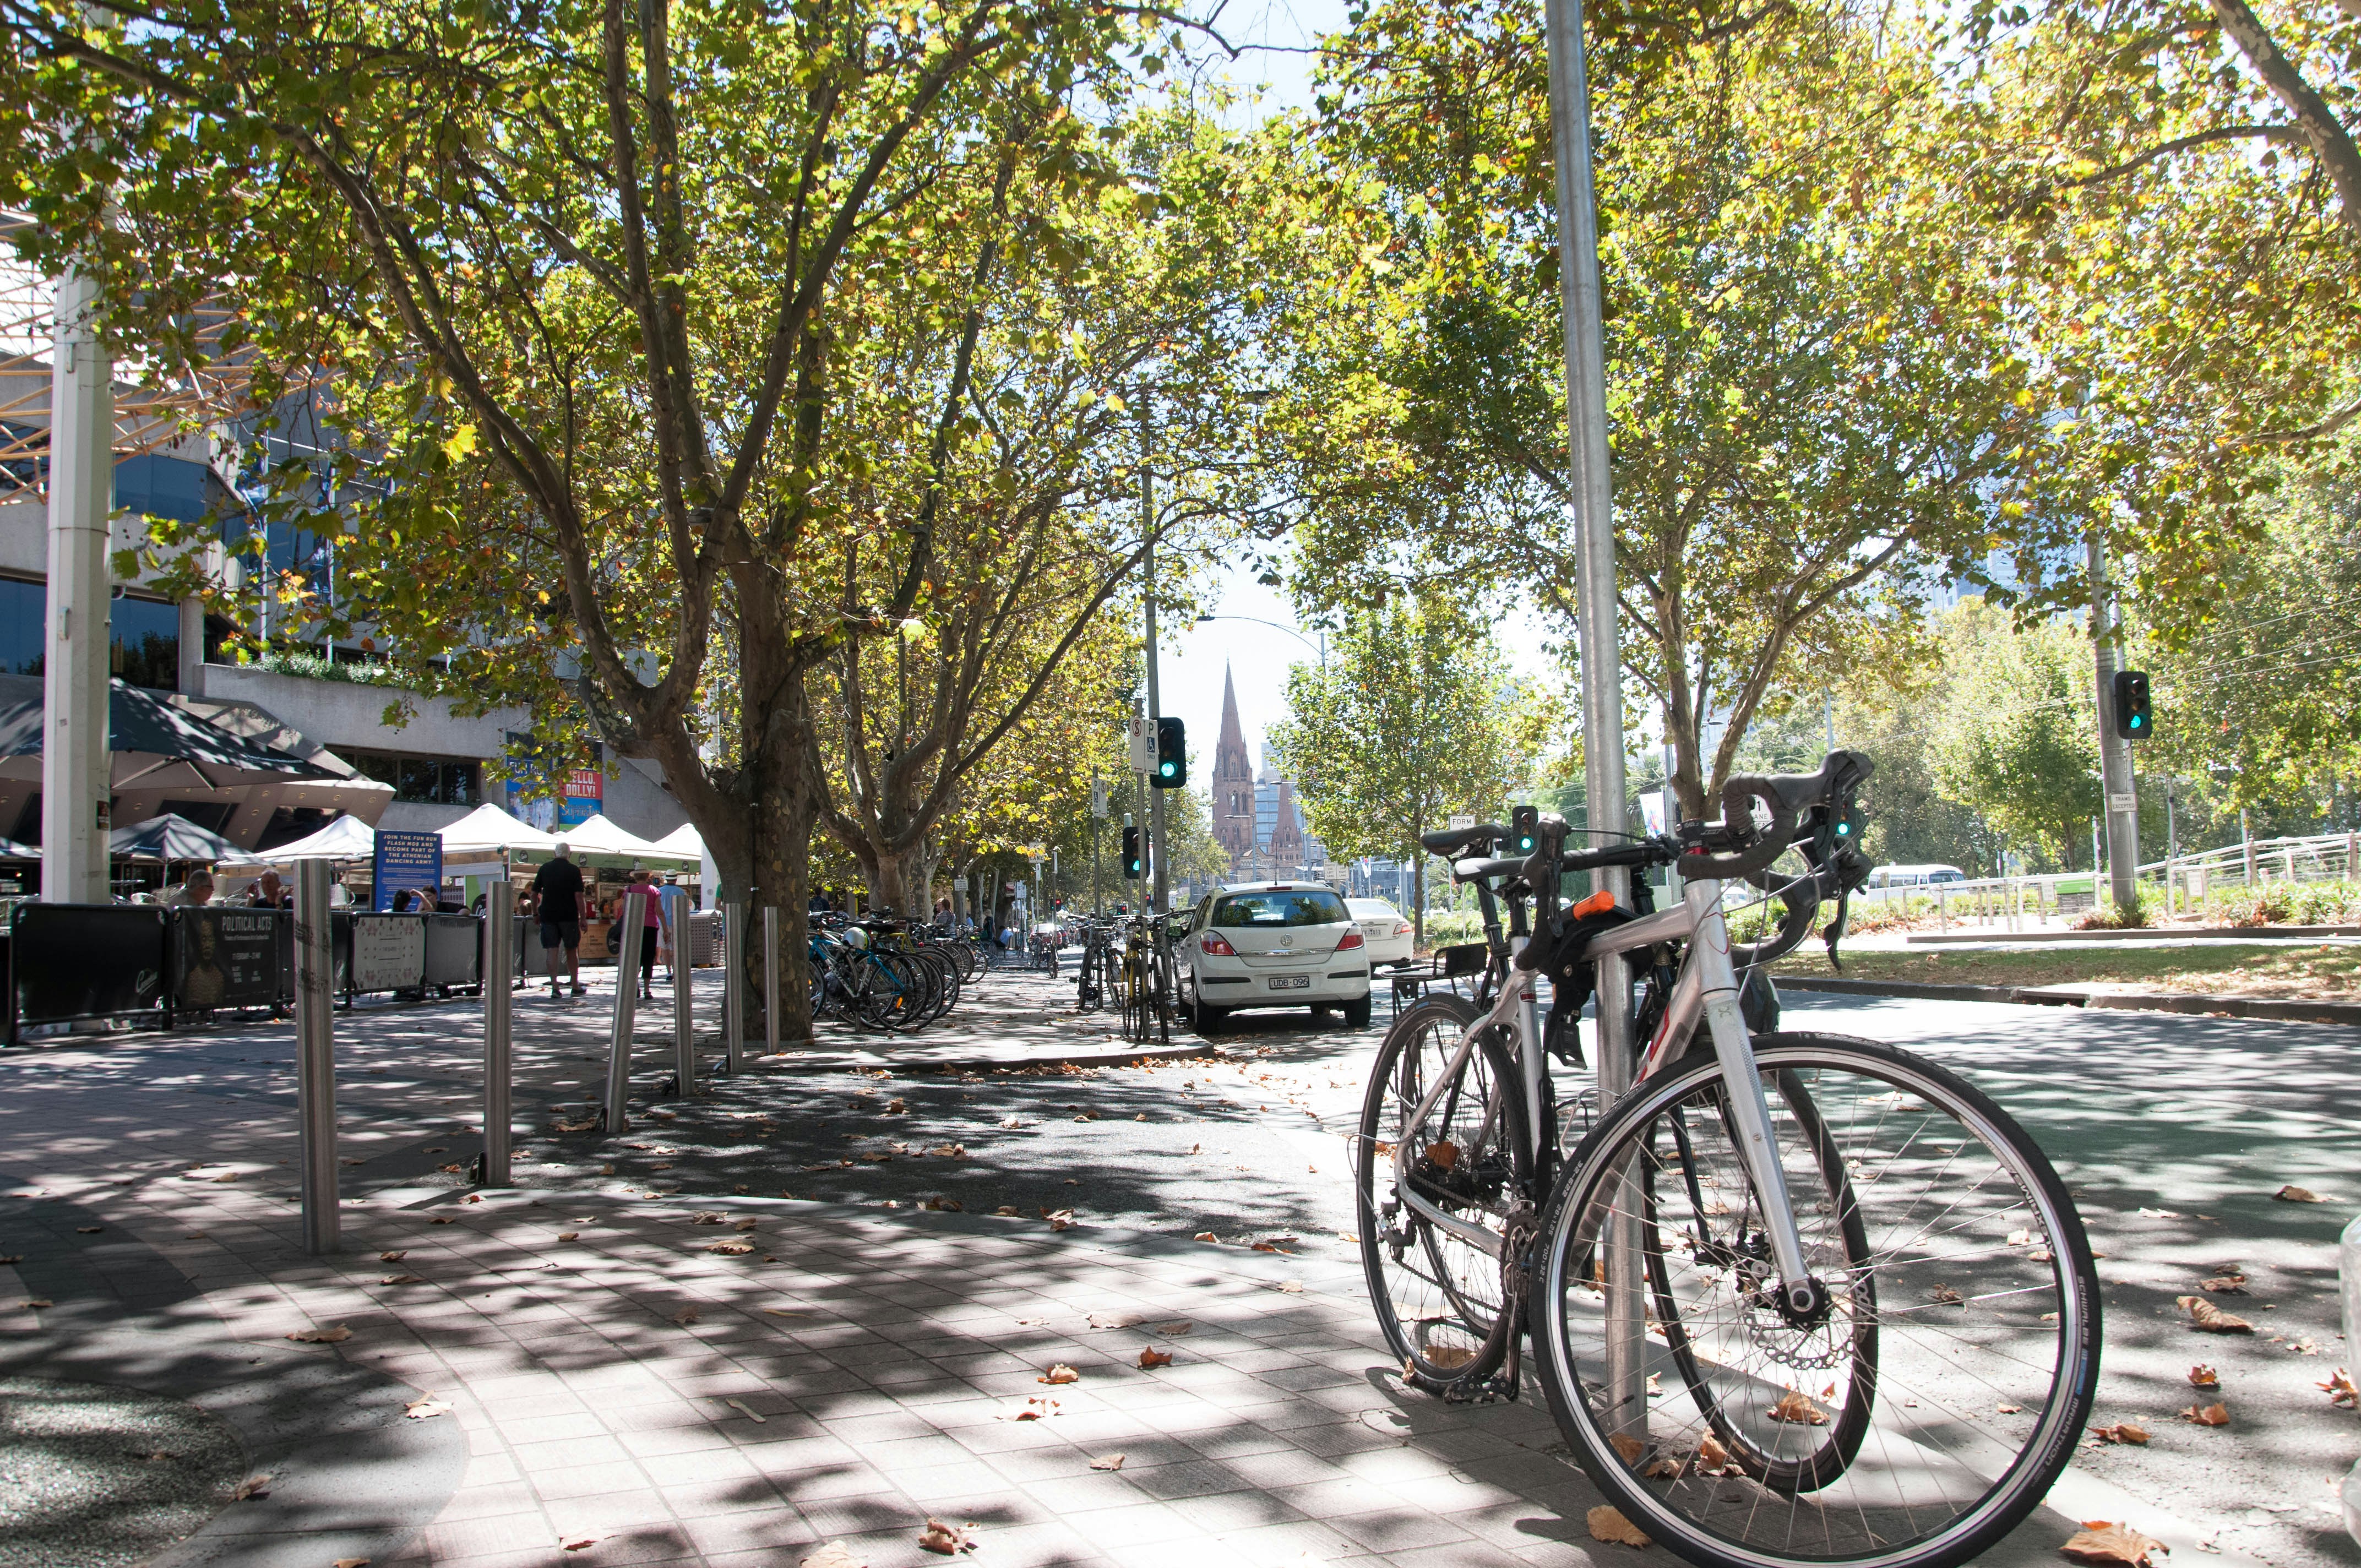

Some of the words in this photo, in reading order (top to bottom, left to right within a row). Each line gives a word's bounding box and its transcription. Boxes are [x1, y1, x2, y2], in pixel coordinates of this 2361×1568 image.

[1149, 722, 1154, 735] P
[566, 783, 596, 798] DOLLY!
[1757, 801, 1760, 811] 1
[222, 916, 255, 932] POLITICAL
[257, 916, 272, 931] ACTS
[2077, 1275, 2090, 1346] SCHWALBE
[2045, 1397, 2080, 1467] MARATHON
